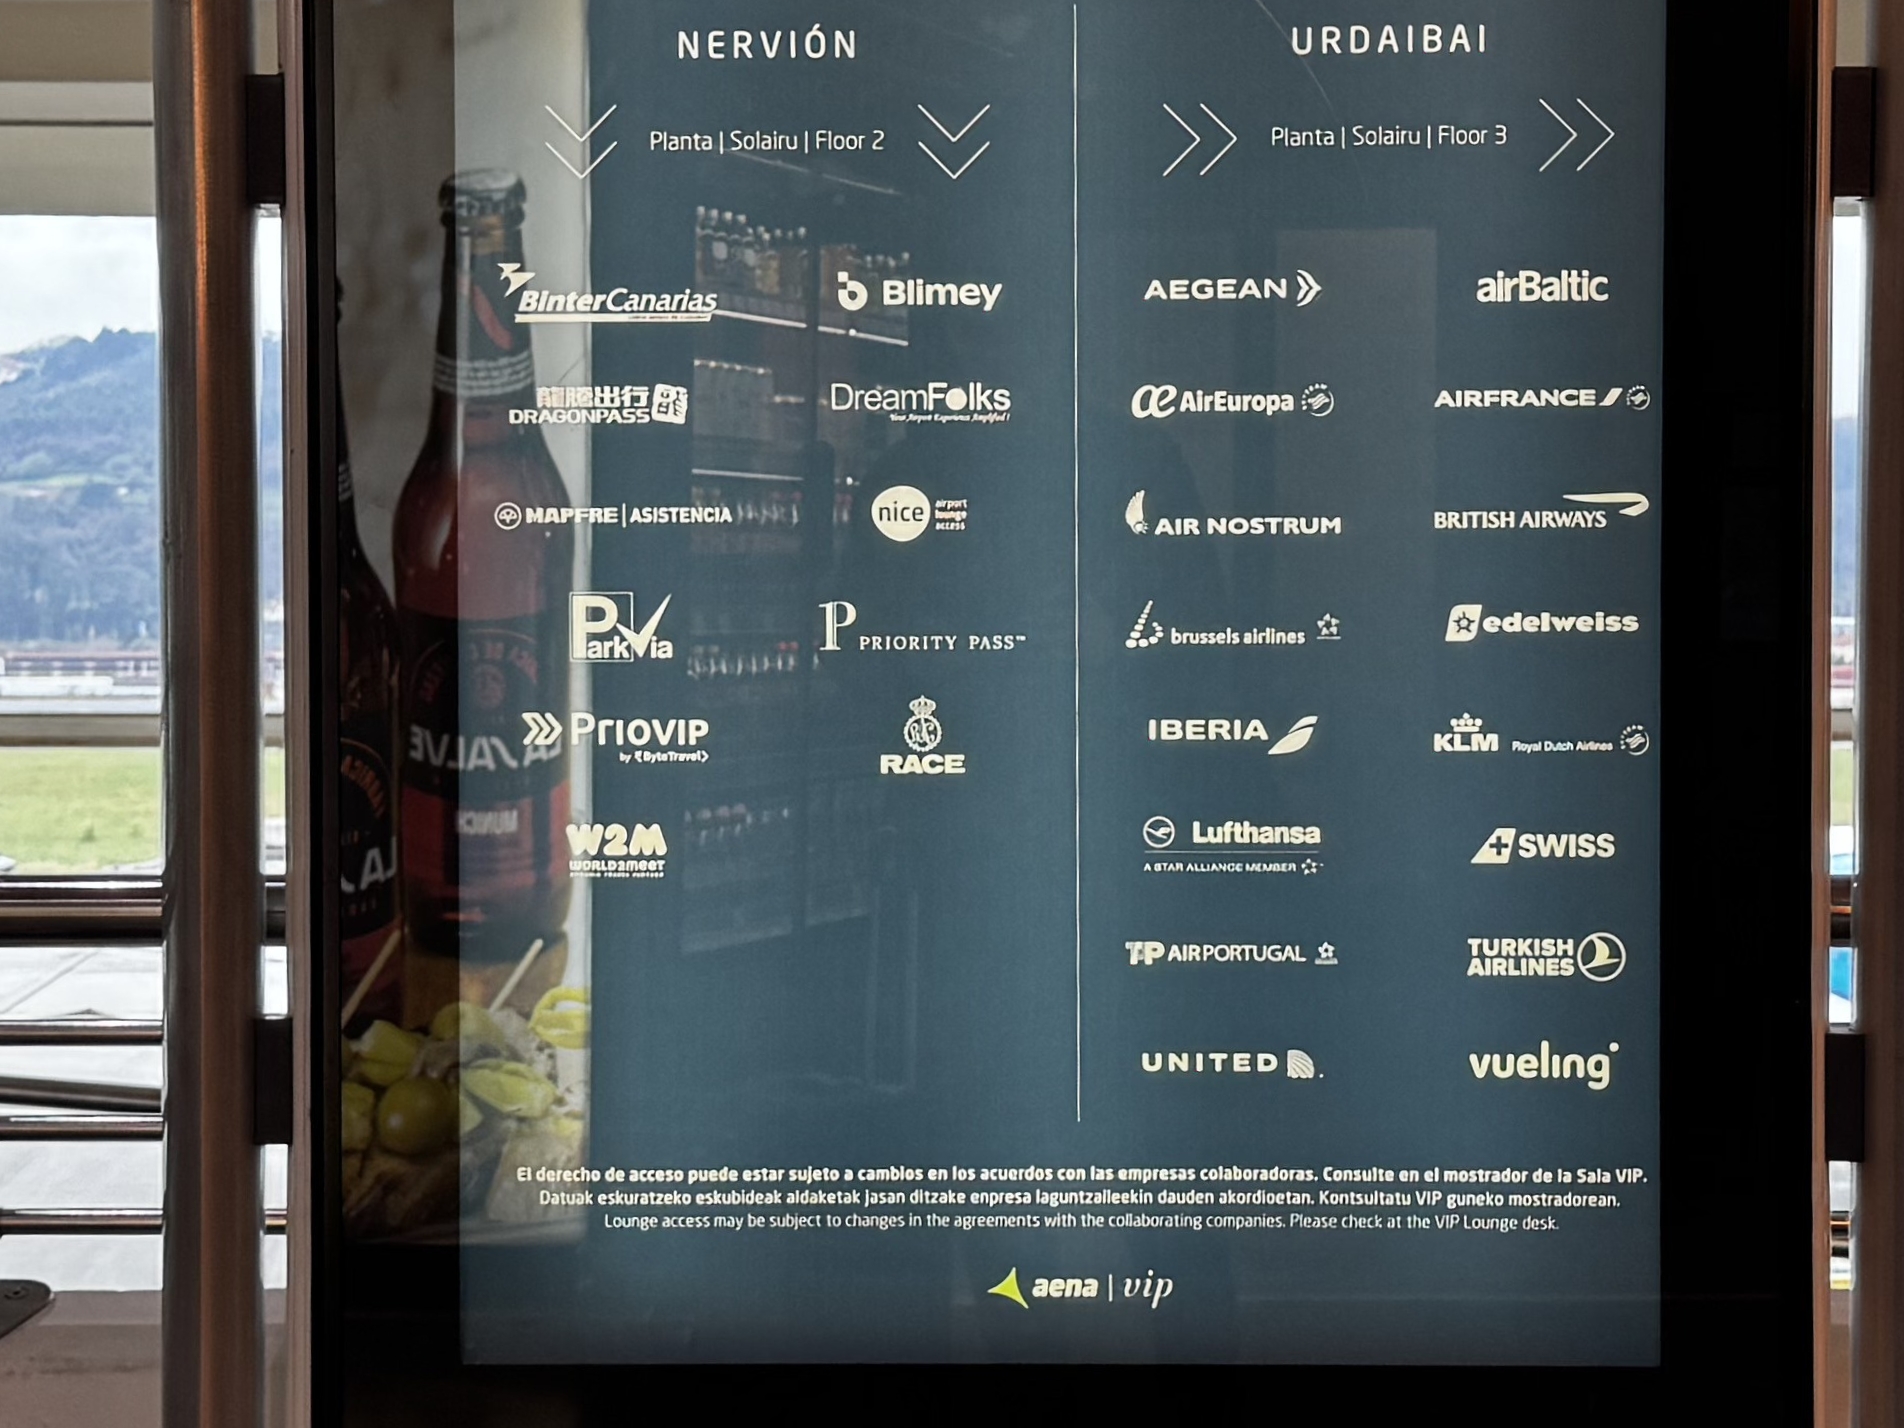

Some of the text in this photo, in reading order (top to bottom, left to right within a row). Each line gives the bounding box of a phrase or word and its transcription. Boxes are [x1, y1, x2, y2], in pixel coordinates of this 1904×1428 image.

[678, 23, 855, 60] NERVIÓN
[1291, 23, 1485, 56] URDAIBAI
[650, 129, 885, 151] Planta Solairu Floor 2
[1271, 124, 1507, 147] Planta Solairu Floor 3
[882, 278, 1003, 312] Blimey
[1143, 277, 1288, 300] AEGEAN
[1476, 269, 1609, 303] airBaltic
[508, 407, 651, 425] DRAGONPASS
[526, 506, 733, 525] MAPFRE ASISTENCIA
[878, 500, 925, 523] nice
[1434, 510, 1608, 529] BRITISH AIRWAYS
[1154, 516, 1342, 536] AIR NOSTRUM
[1482, 611, 1640, 633] edelweiss
[859, 635, 957, 651] PRIORITY
[1170, 626, 1306, 645] brussels airlines
[1148, 718, 1269, 741] IBERIA
[1433, 729, 1614, 754] KLM Royal Dutch Airlines
[880, 753, 966, 775] RACE
[565, 821, 668, 859] W2M
[1192, 820, 1322, 845] Lufthansa
[1517, 832, 1616, 859] SWISS
[1467, 937, 1575, 957] TURKISH
[1466, 957, 1575, 977] AIRLINES
[1141, 1052, 1279, 1073] UNITED
[1468, 1039, 1620, 1091] vueling
[516, 1164, 1648, 1185] El derecho de acceso puede estar sujeto a cambios en los acuerdos con las empresas colaboradoras. Consulte en el mostrador de la Sala VIP.
[539, 1189, 594, 1206] Datuak
[597, 1189, 692, 1206] eskuratzeko
[695, 1188, 782, 1206] eskubideak
[785, 1188, 861, 1205] aldaketak
[864, 1188, 906, 1208] jasan
[909, 1188, 967, 1205] ditzake
[969, 1191, 1032, 1208] enpresa
[1157, 1188, 1215, 1205] dauden
[1218, 1189, 1315, 1205] akordioetan.
[1318, 1189, 1412, 1206] Kontsultatu
[1414, 1190, 1443, 1206] VIP
[1446, 1190, 1505, 1210] guneko
[1508, 1191, 1621, 1208] mostradorean.
[604, 1212, 1559, 1233] Lounge access may be subject to changes in the agreements with the collaborating companies. Please check at the VIP Lounge desk.
[1031, 1269, 1174, 1309] aena vip
